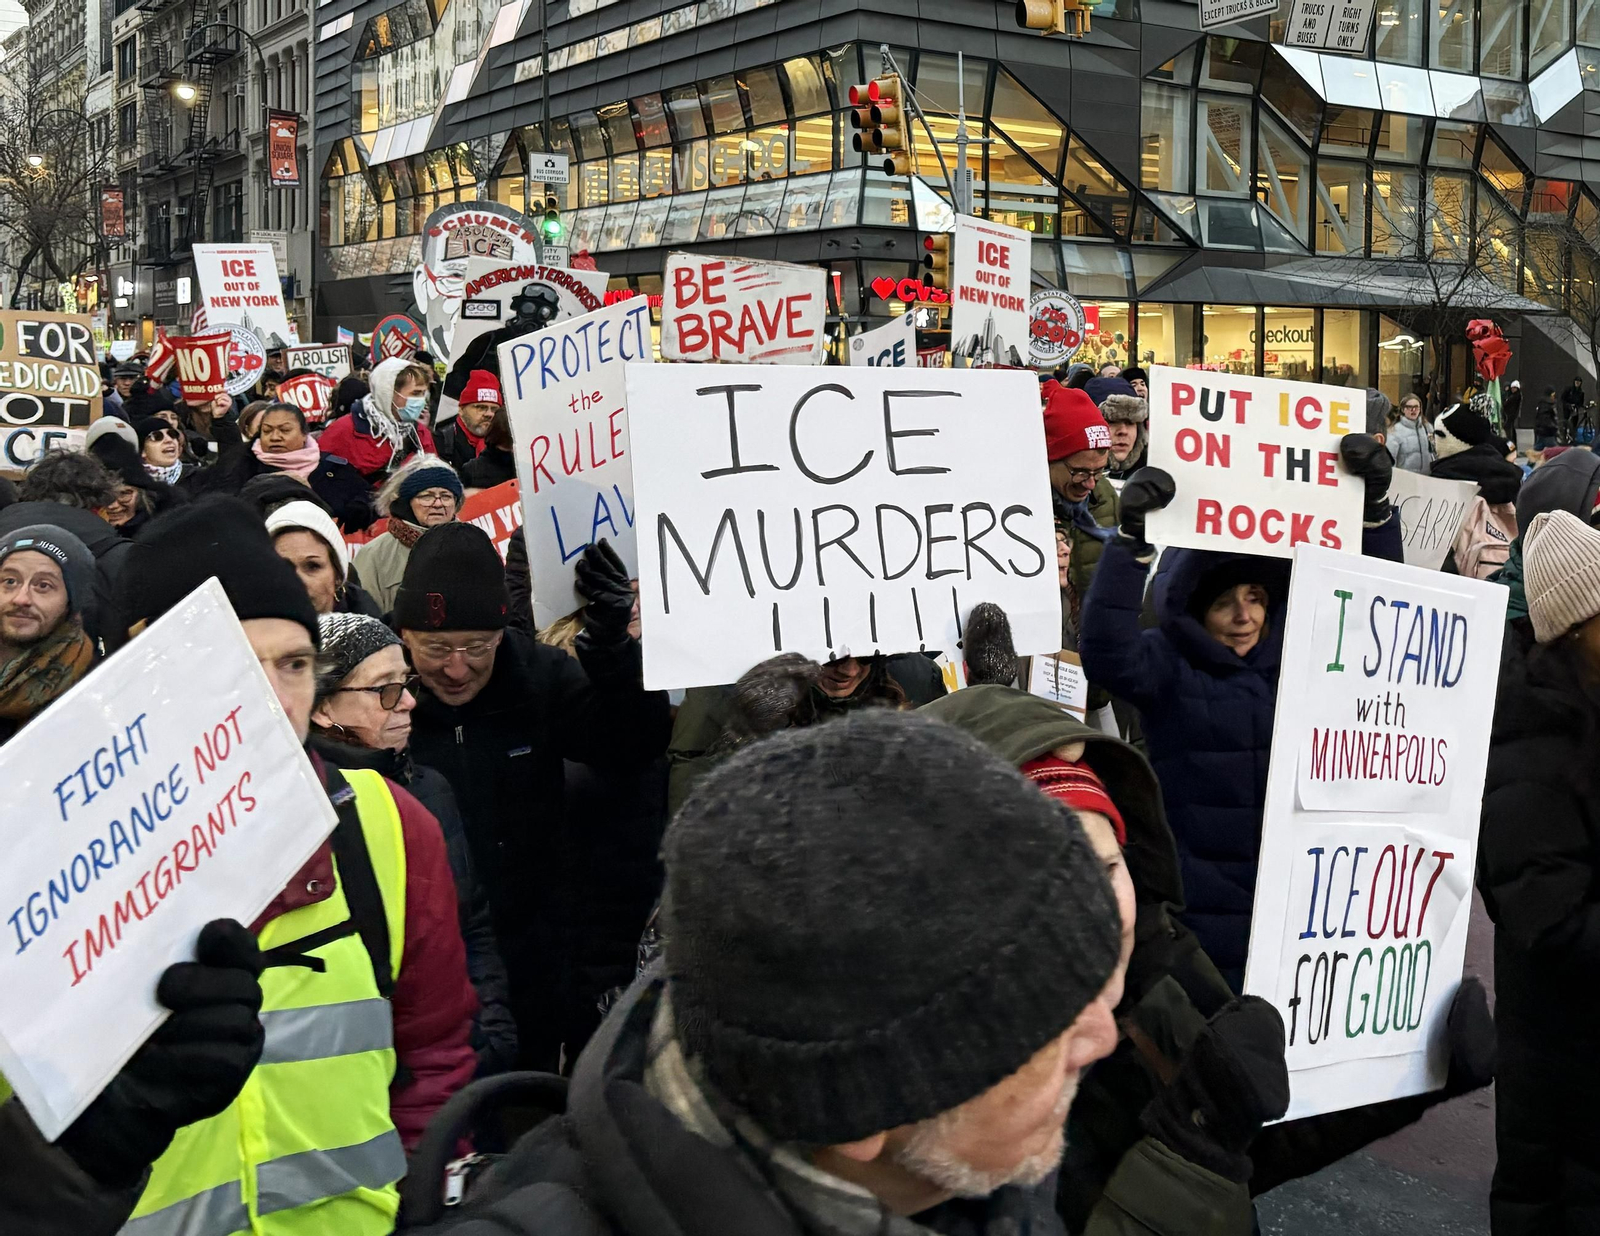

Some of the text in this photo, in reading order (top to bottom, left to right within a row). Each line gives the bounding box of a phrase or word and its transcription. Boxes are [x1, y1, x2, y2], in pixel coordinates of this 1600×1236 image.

[1204, 7, 1224, 20] EXCEPT
[1226, 3, 1247, 15] TRUCKS
[1301, 3, 1325, 16] TRUCKS
[1302, 18, 1316, 29] AND
[1342, 7, 1362, 19] RIGHT
[1296, 32, 1317, 43] BUSES
[1337, 36, 1355, 47] ONLY
[1338, 21, 1360, 33] TURNS
[271, 151, 294, 160] SQUARE
[694, 131, 811, 188] SCHOOL
[428, 214, 535, 245] SCHUMER
[455, 228, 510, 247] ABOLISH
[466, 238, 501, 257] ICE
[978, 240, 1010, 270] ICE
[221, 259, 257, 278] ICE
[465, 265, 535, 299] AMERICAN
[673, 261, 727, 309] BE
[976, 270, 1011, 288] OUT OF
[210, 295, 279, 308] NEW YORK
[224, 281, 260, 291] OUT OF
[960, 285, 989, 305] NEW
[991, 291, 1025, 313] YORK
[16, 320, 94, 364] FOR
[674, 293, 815, 359] BRAVE
[1029, 314, 1080, 349] OOD
[1250, 325, 1314, 344] ceckout
[176, 347, 211, 382] NO
[292, 348, 347, 366] ABOLISH
[511, 305, 648, 400] PROTECT
[0, 362, 100, 397] EDICAID
[282, 383, 314, 409] NO
[0, 393, 89, 427] OT
[568, 389, 604, 414] the
[1171, 382, 1350, 435] PUT ICE
[530, 407, 625, 494] RULE
[696, 383, 962, 485] ICE
[1175, 428, 1338, 487] ON THE
[1196, 499, 1342, 550] ROCKS
[657, 501, 1046, 615] MURDERS
[1326, 589, 1468, 689] I STAND
[1357, 691, 1406, 729] with
[53, 713, 149, 822] FIGHT
[1310, 728, 1448, 786] MINNEAPOLIS
[7, 705, 243, 955] IGNORANCE NOT
[62, 771, 257, 988] IMMIGRANTS
[1299, 844, 1455, 940] ICE OUT
[1288, 939, 1432, 1047] for GOOD
